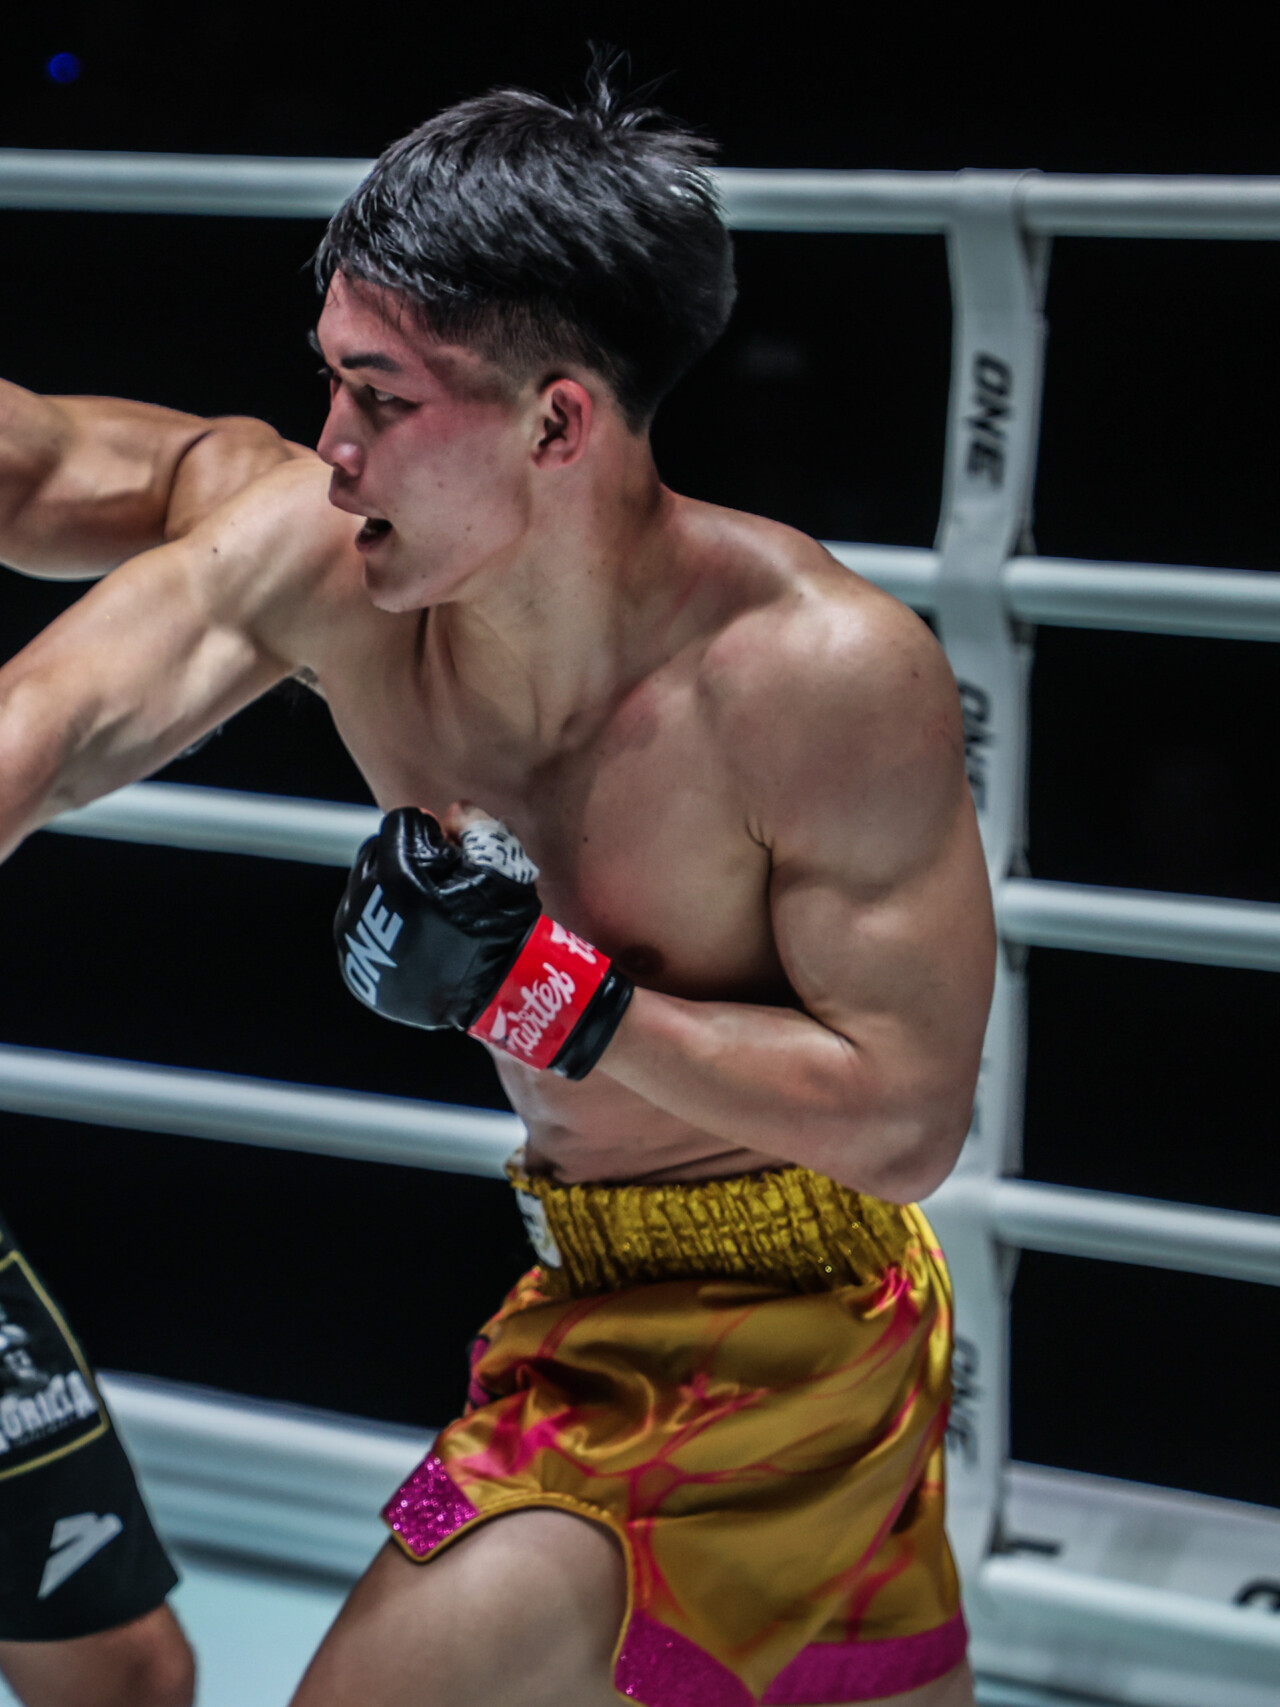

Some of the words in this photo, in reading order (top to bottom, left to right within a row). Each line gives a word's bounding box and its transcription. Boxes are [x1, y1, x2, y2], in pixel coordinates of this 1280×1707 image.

[964, 352, 1013, 490] ONE
[344, 884, 403, 1006] ONE
[490, 962, 576, 1057] Fairtex
